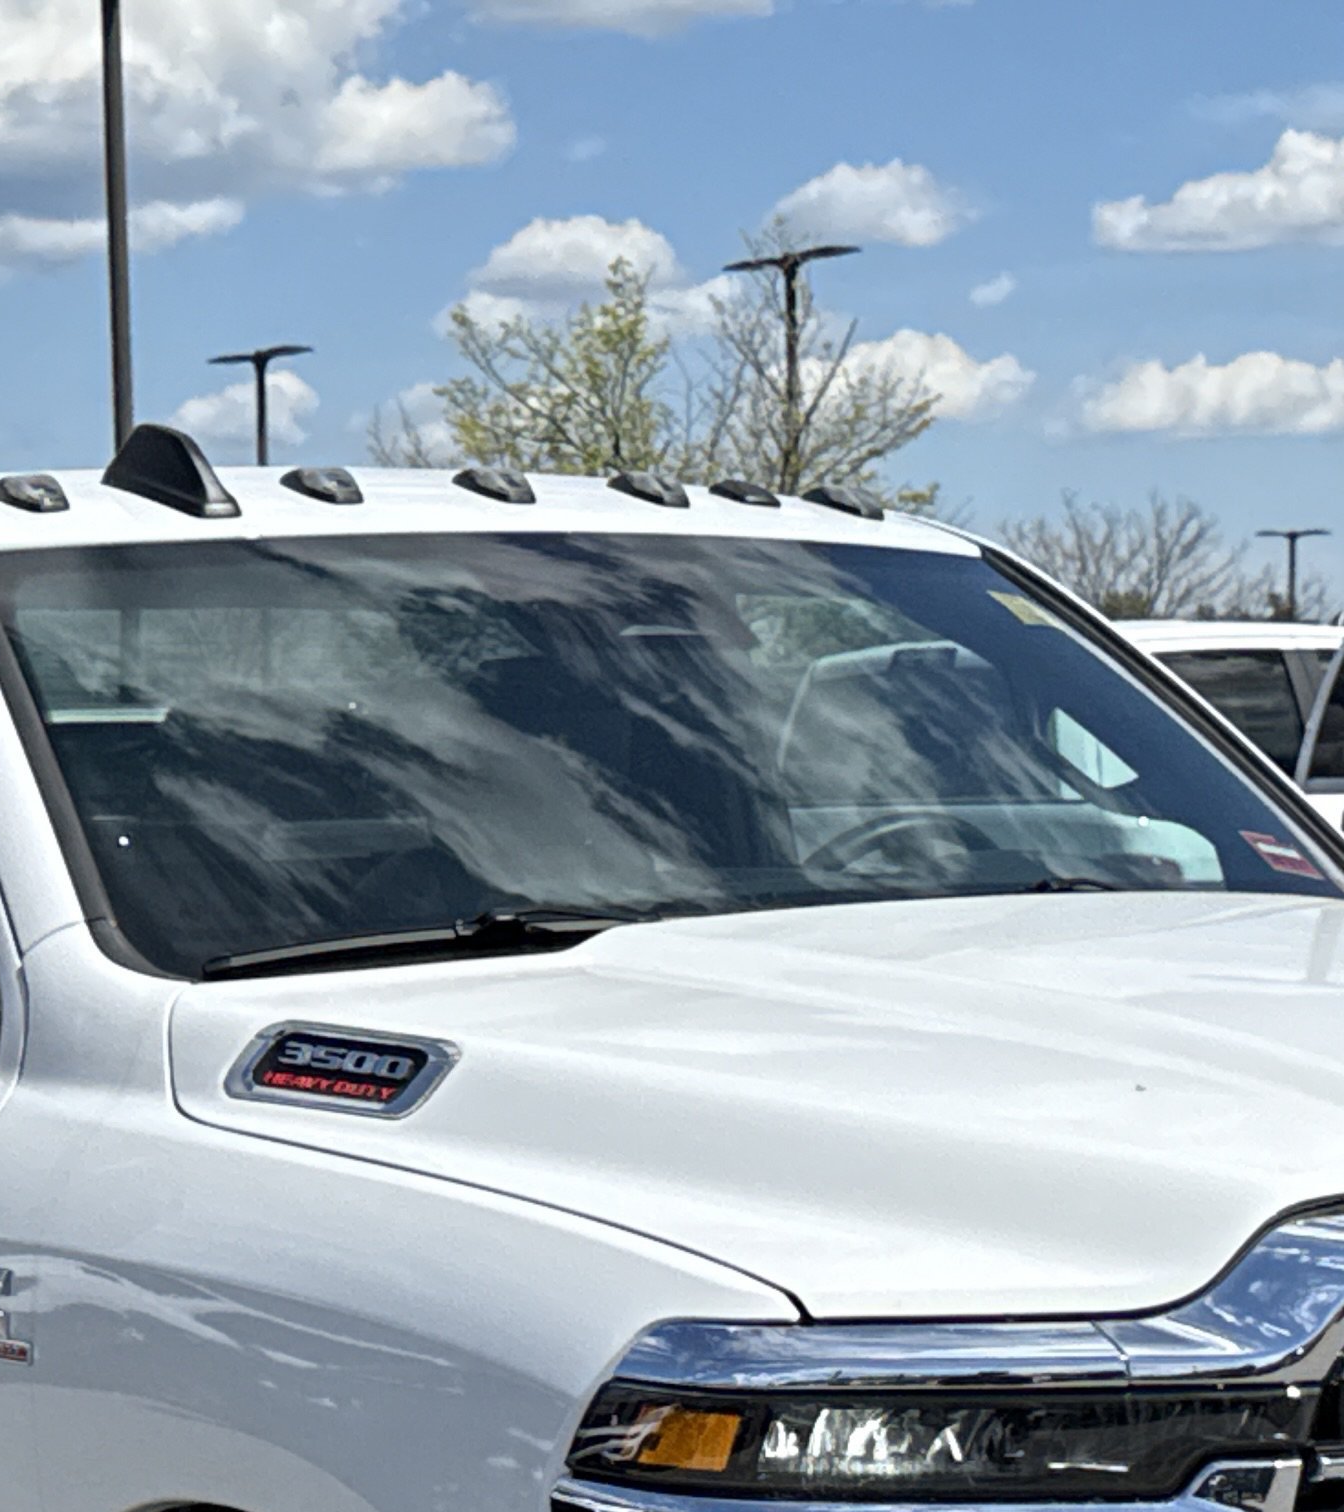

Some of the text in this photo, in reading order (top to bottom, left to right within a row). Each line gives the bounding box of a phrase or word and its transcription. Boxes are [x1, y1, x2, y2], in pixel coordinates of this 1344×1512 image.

[277, 1040, 415, 1080] 3500
[262, 1070, 398, 1101] HEAVY DUTY
